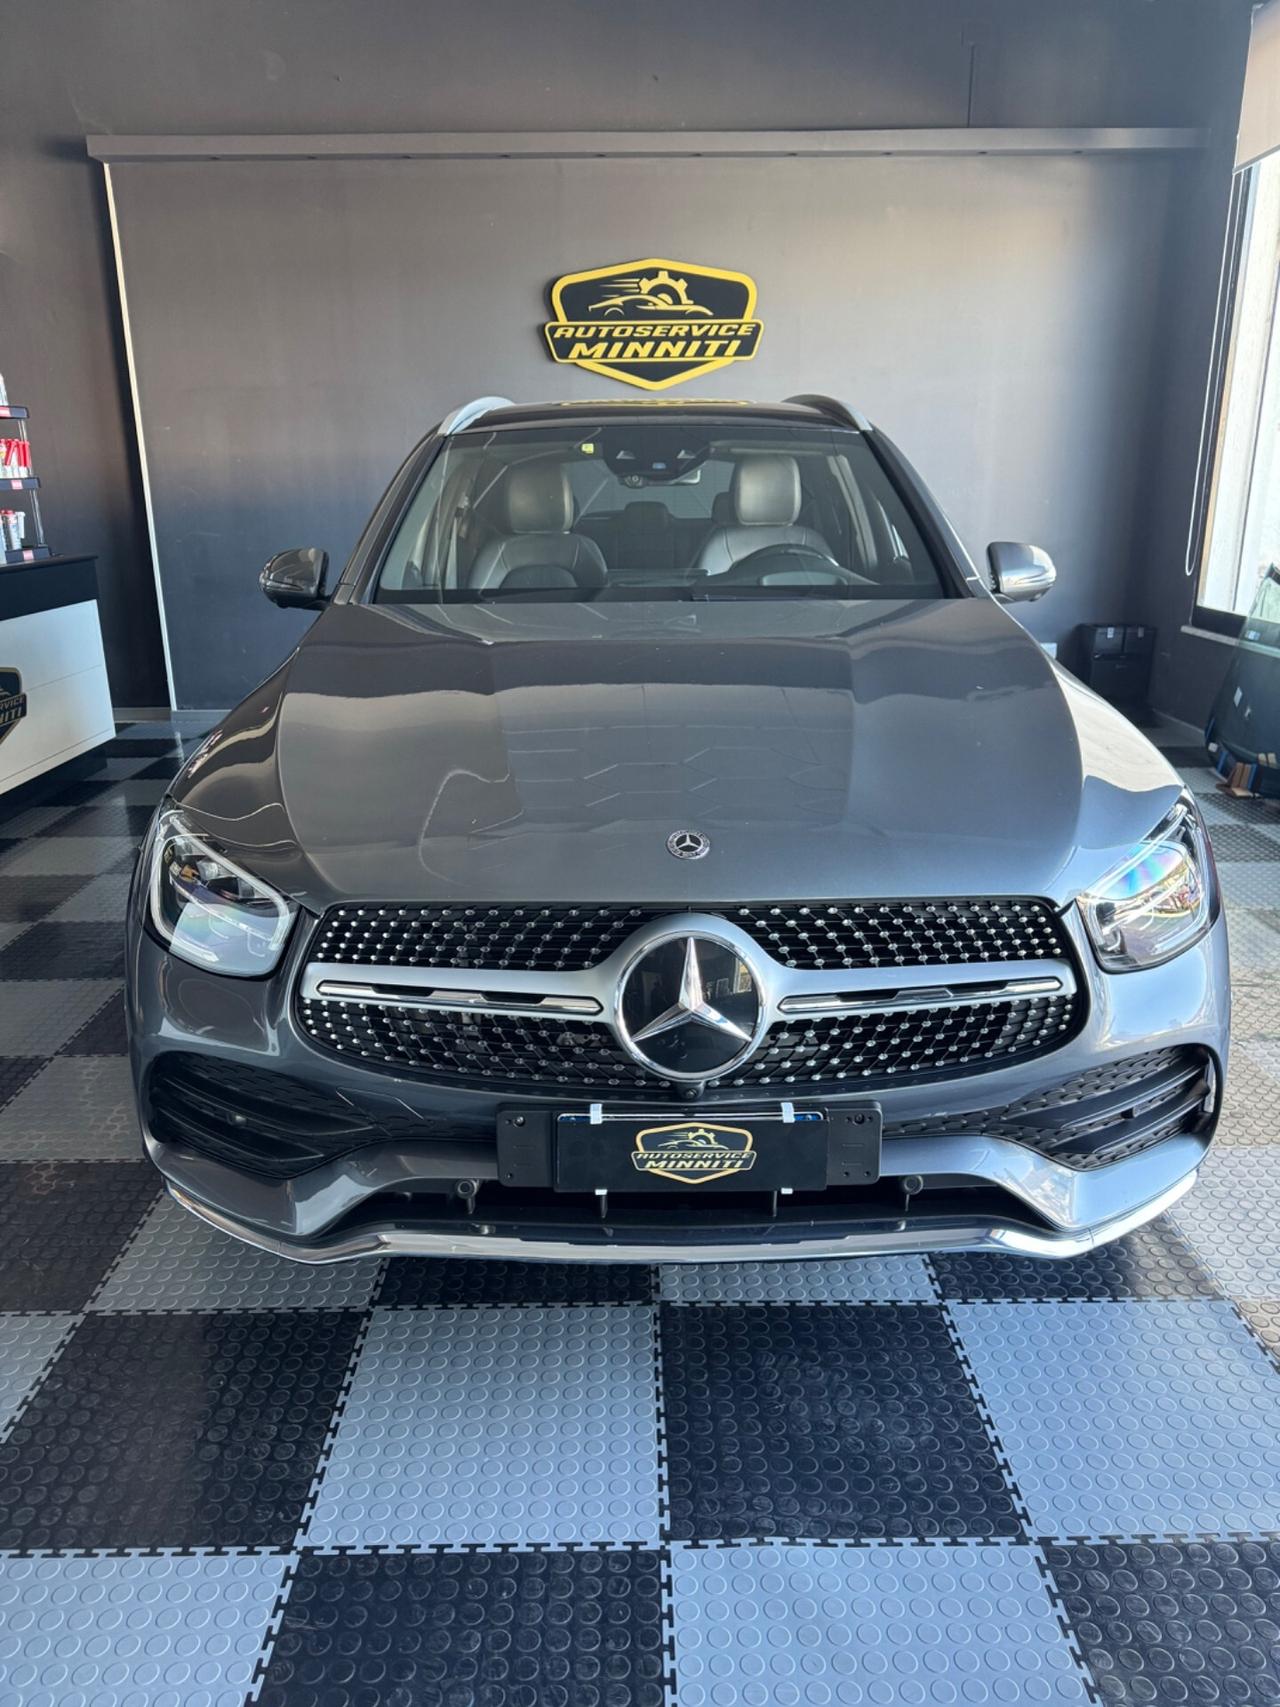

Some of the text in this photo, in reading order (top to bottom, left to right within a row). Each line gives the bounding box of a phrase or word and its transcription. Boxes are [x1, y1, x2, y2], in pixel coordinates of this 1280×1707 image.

[553, 324, 755, 338] AUTOSERVICE
[568, 340, 741, 359] MINNITI
[645, 1160, 744, 1168] MINNITI
